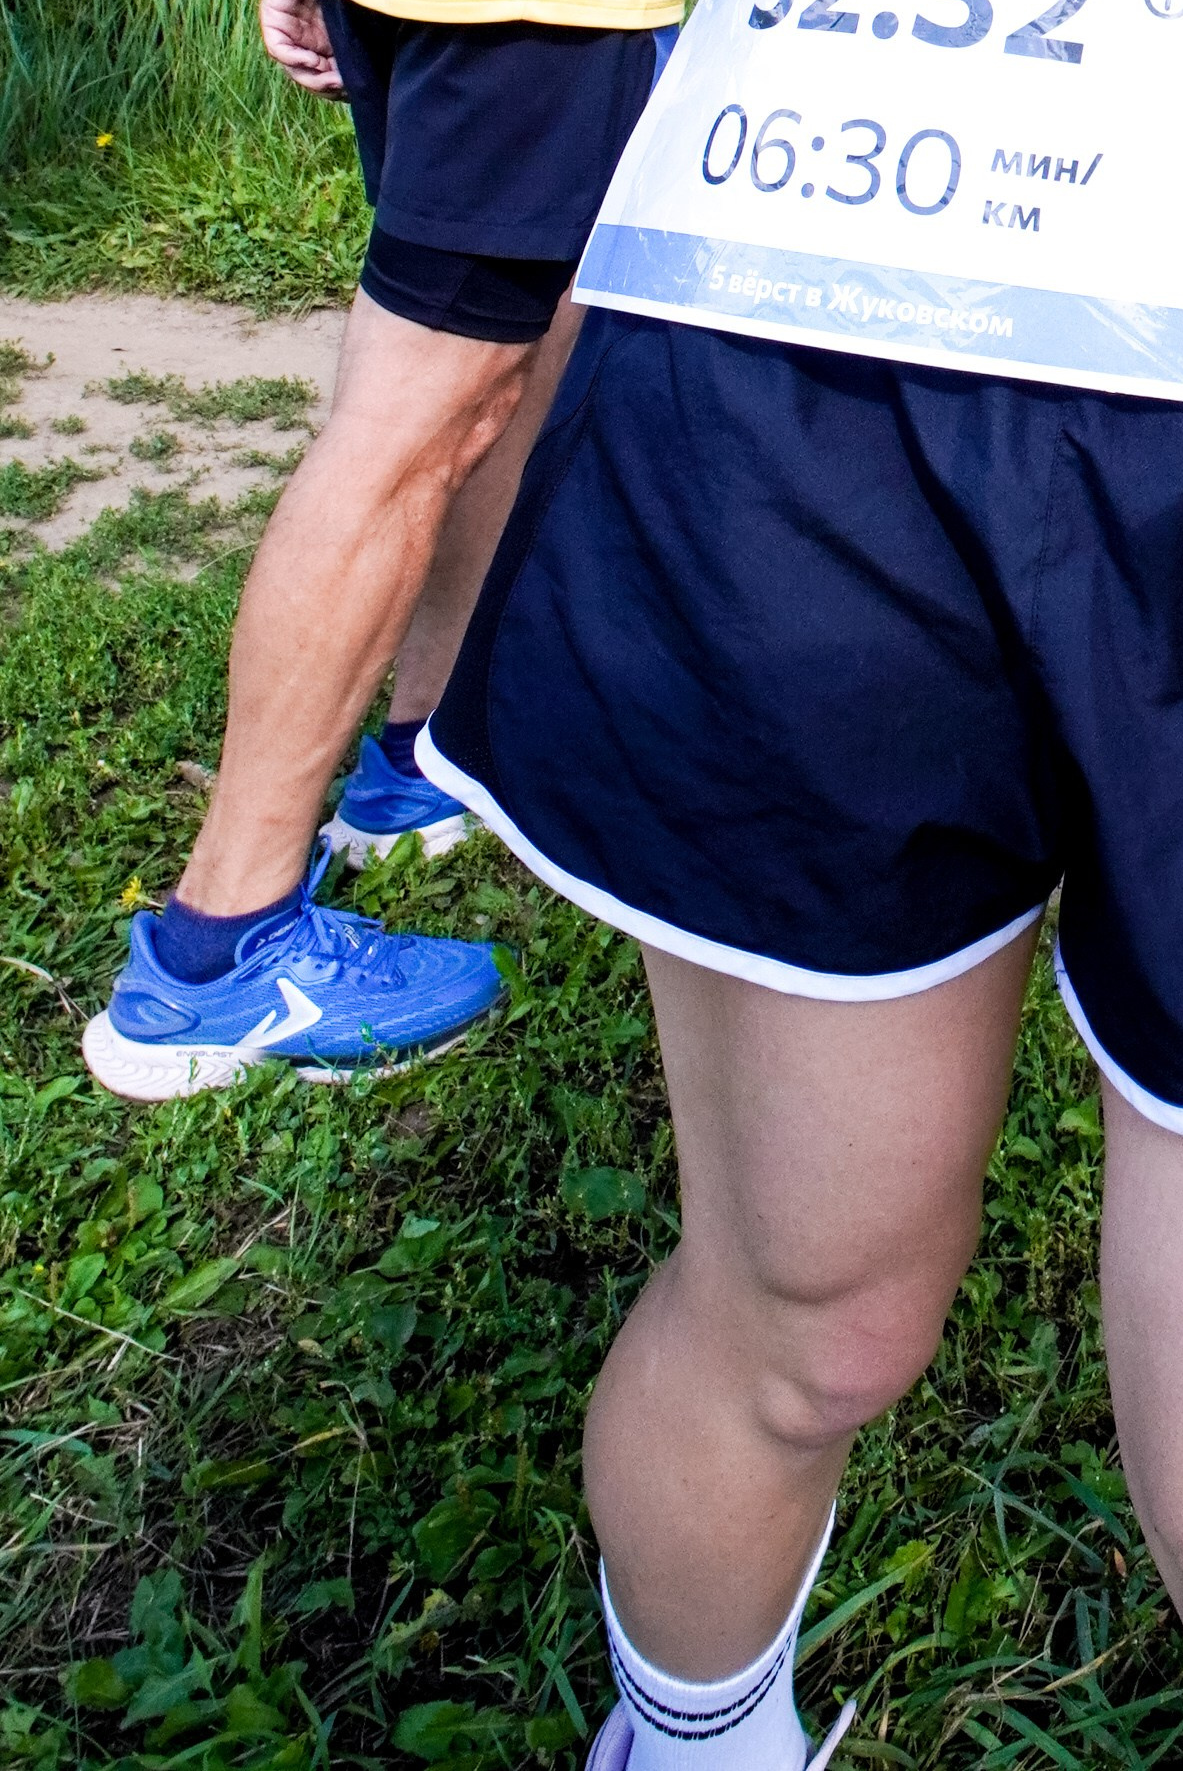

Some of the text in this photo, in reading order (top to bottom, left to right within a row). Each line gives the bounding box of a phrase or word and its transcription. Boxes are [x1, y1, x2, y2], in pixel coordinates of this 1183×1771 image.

[701, 103, 962, 216] 06:30
[981, 199, 1042, 232] км
[708, 265, 1014, 338] 5 вёрст в Жуковском
